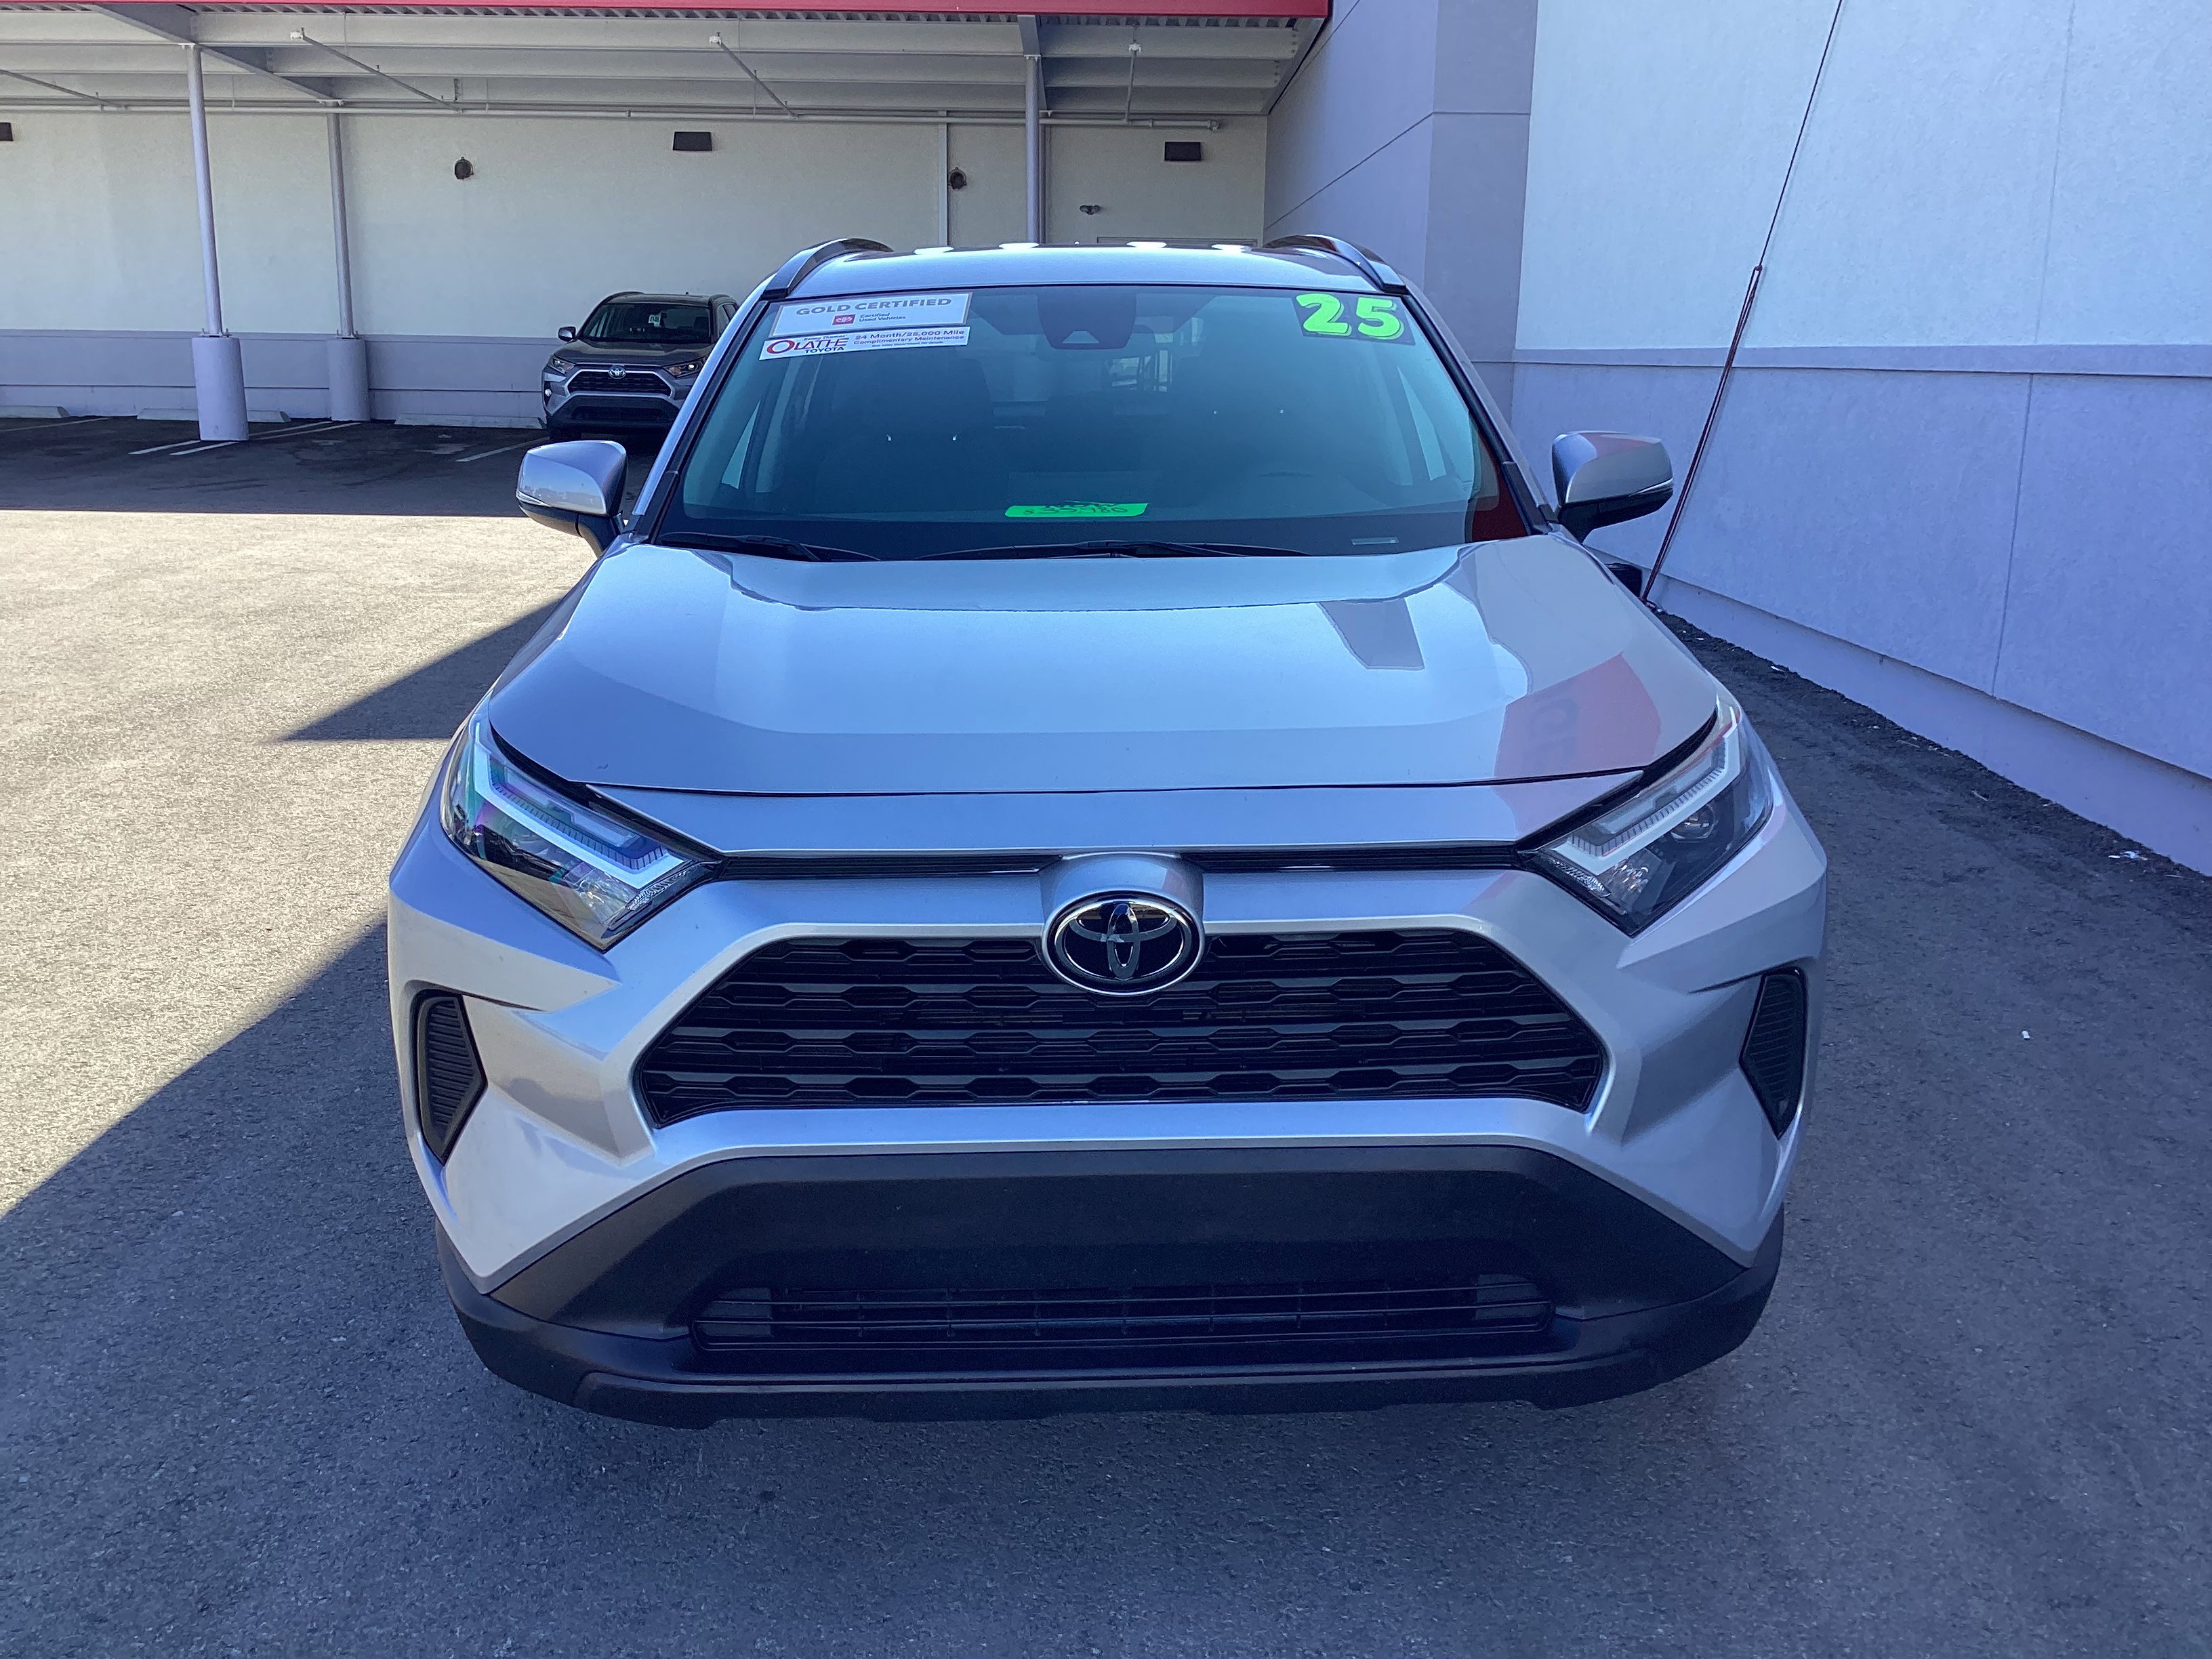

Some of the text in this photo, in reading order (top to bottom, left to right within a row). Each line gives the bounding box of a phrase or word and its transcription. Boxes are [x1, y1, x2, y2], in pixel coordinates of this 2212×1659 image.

[796, 298, 952, 315] GOLD CERTIFIED
[1296, 293, 1404, 340] 25
[766, 337, 848, 354] OLATHE
[853, 336, 913, 345] Complimentary
